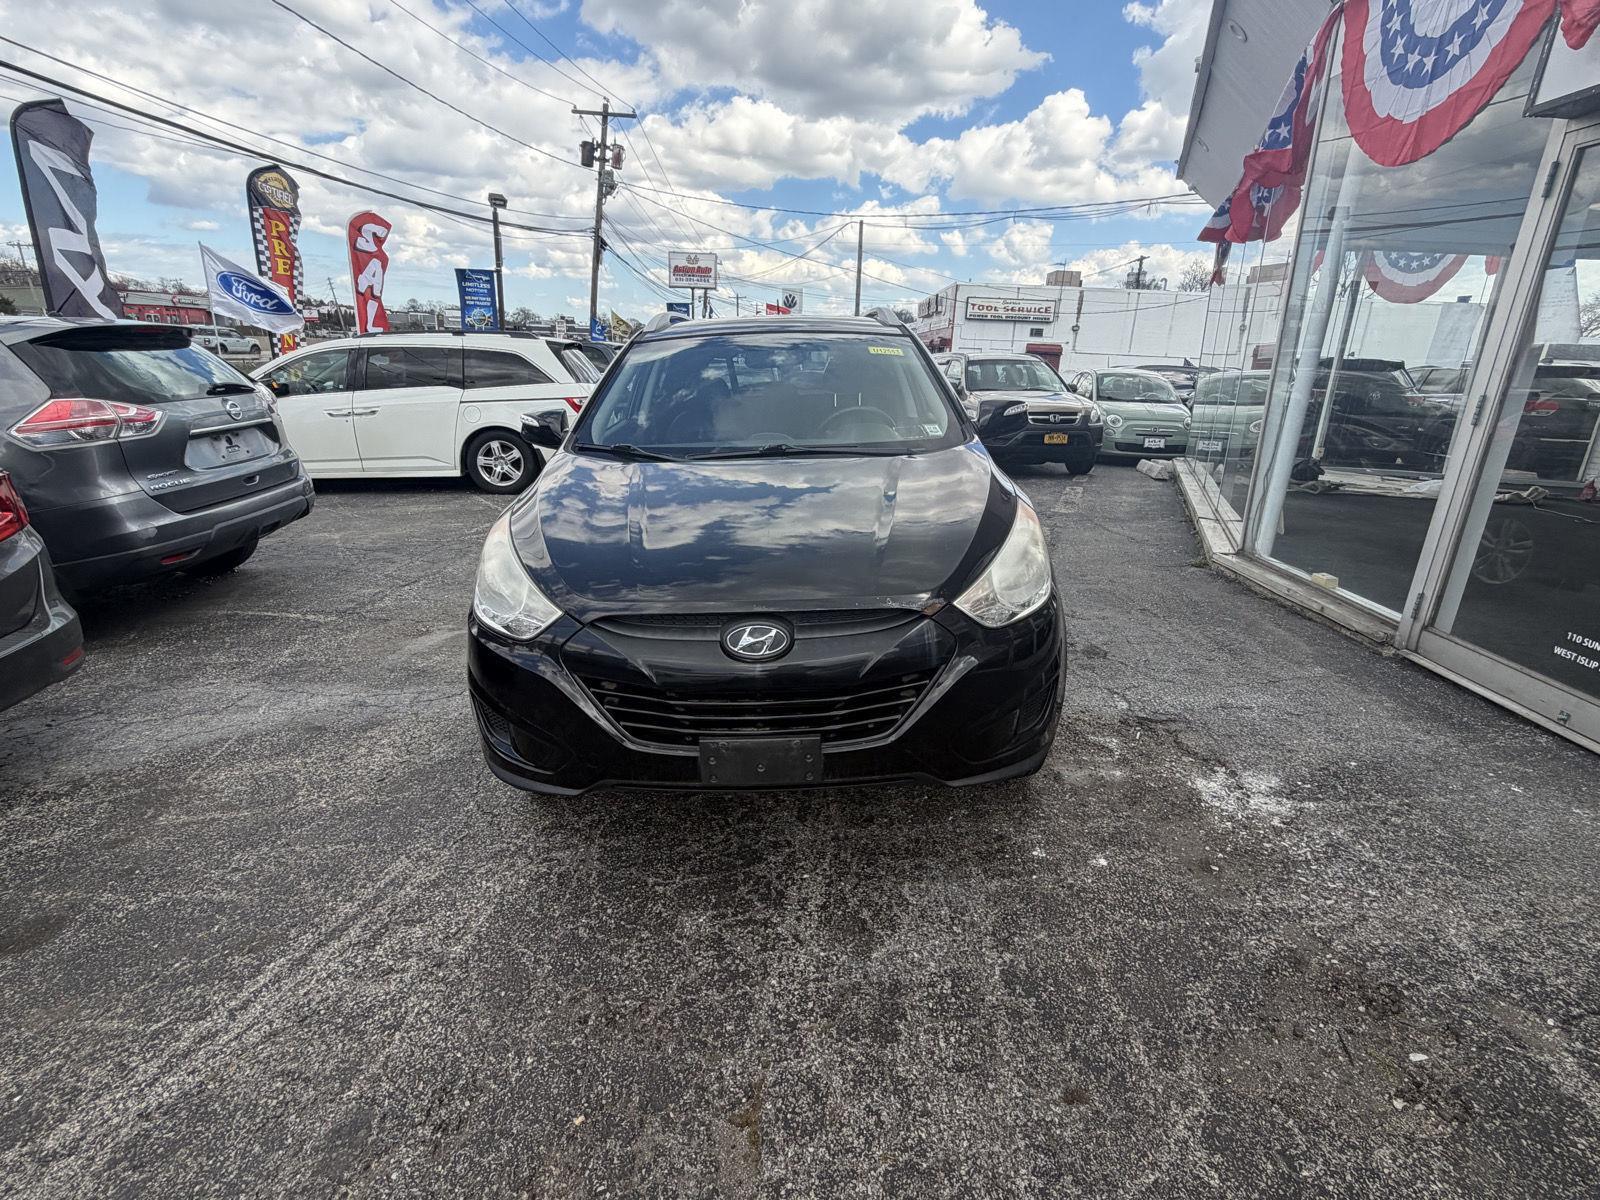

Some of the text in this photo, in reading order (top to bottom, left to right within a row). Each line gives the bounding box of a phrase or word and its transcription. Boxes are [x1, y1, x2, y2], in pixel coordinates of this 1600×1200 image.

[231, 276, 279, 310] Ford
[1004, 306, 1052, 314] SERVICE
[150, 478, 191, 491] ROGUE
[1567, 631, 1582, 644] 110
[1554, 646, 1599, 669] WEST ISLIP
